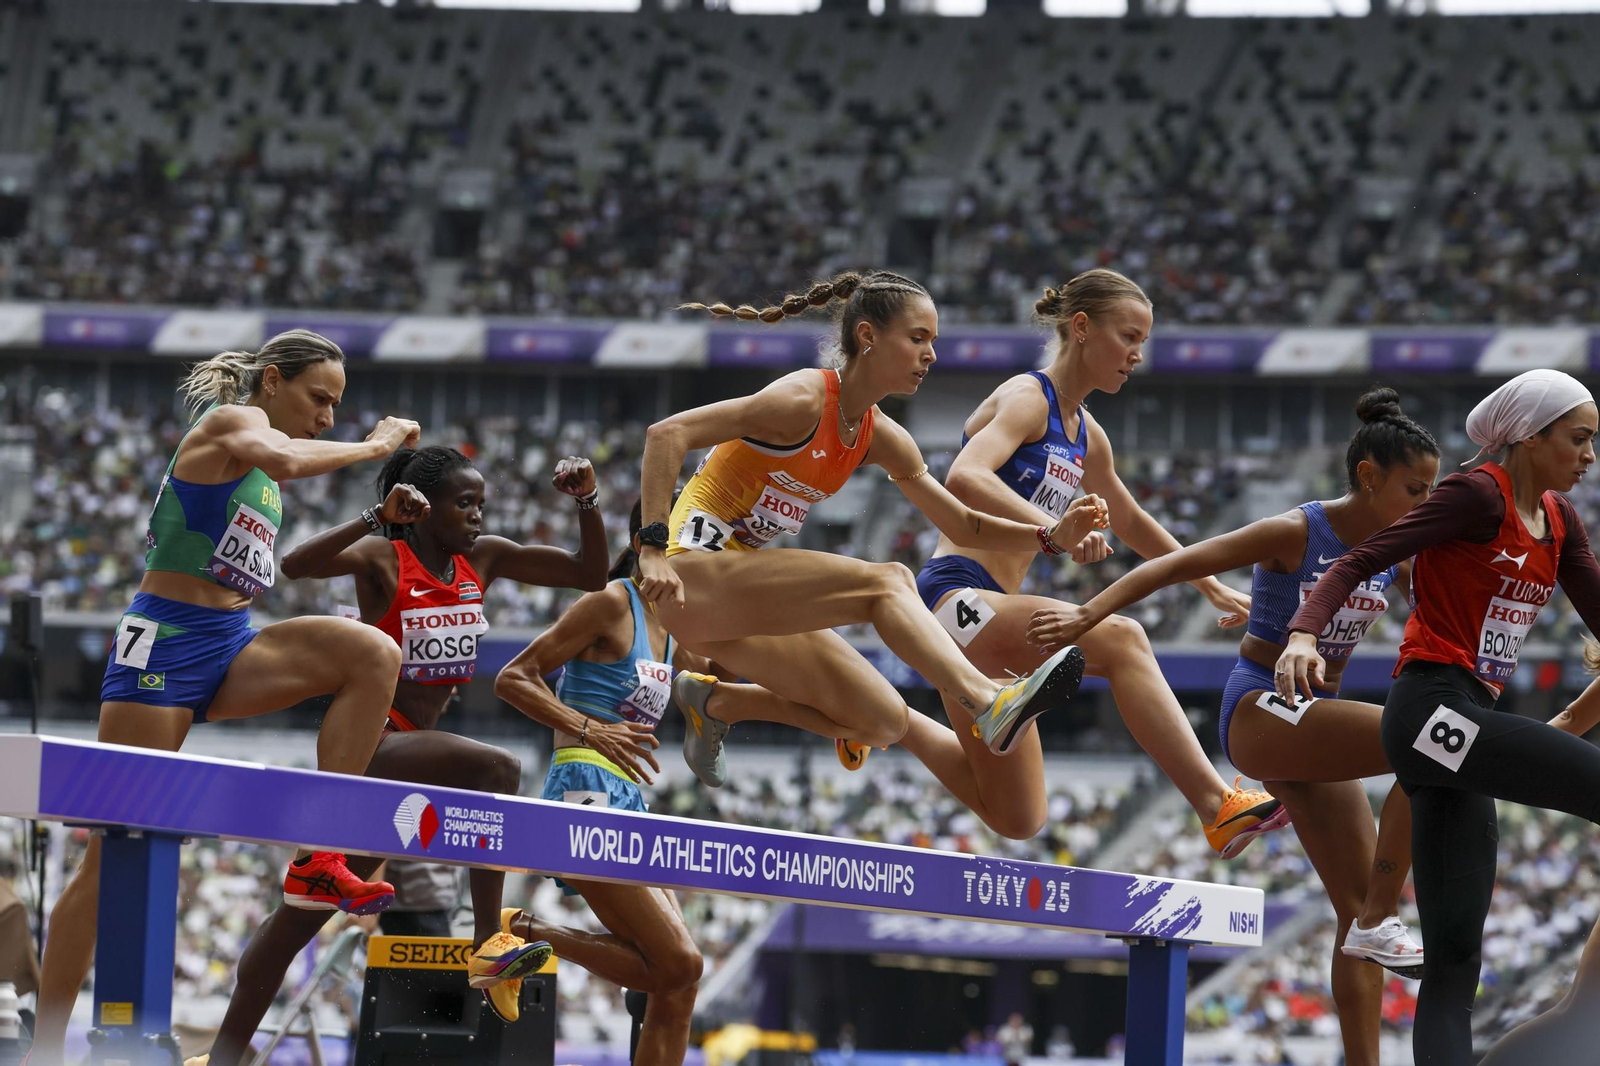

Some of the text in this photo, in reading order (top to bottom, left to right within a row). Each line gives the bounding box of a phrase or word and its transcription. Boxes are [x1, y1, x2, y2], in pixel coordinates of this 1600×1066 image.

[691, 516, 723, 551] 12
[221, 535, 272, 584] DA SILVA
[956, 599, 981, 629] 4
[123, 625, 146, 658] 7
[1430, 721, 1466, 754] 8
[444, 818, 504, 837] CHAMPIONSHIPS
[445, 806, 504, 824] WORLD ATHLETICS
[569, 824, 915, 896] WORLD ATHLETICS CHAMPIONSHIPS
[1229, 911, 1258, 935] NISHI
